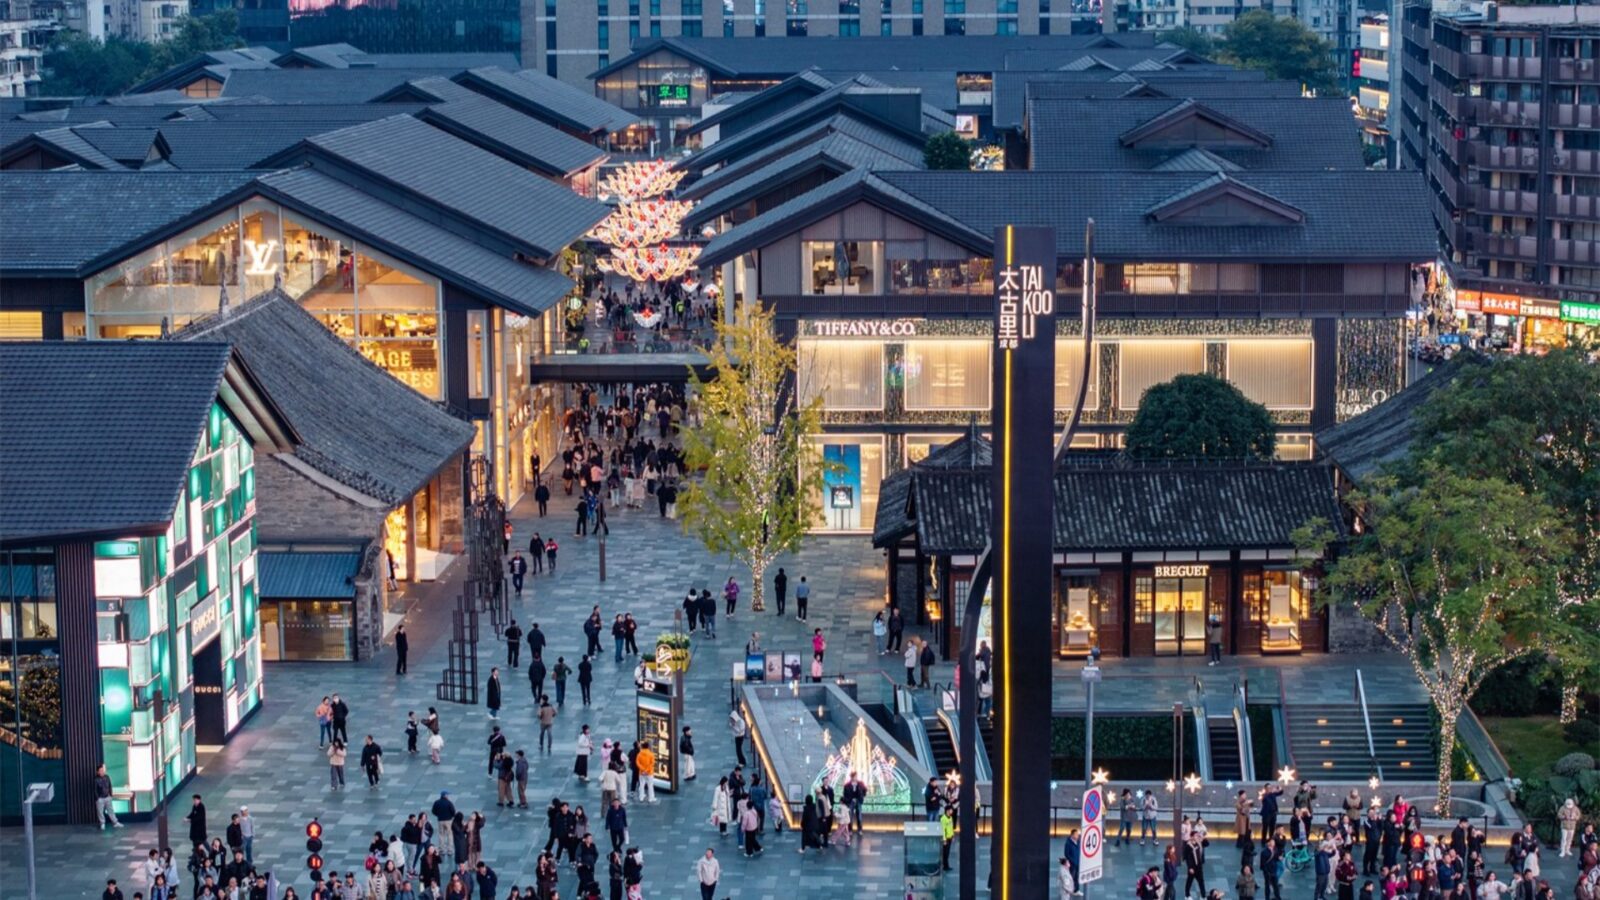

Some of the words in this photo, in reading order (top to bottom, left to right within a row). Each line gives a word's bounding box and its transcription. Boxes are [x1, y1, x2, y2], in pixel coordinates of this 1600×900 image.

[244, 240, 278, 275] LV
[1020, 265, 1042, 290] TAI
[998, 265, 1019, 338] 太古里
[1023, 291, 1052, 315] KOO
[1022, 314, 1035, 339] LI
[1154, 564, 1210, 578] BREGUET
[193, 605, 217, 636] GUCCI
[194, 685, 222, 694] GUCCI
[1085, 833, 1098, 852] 40
